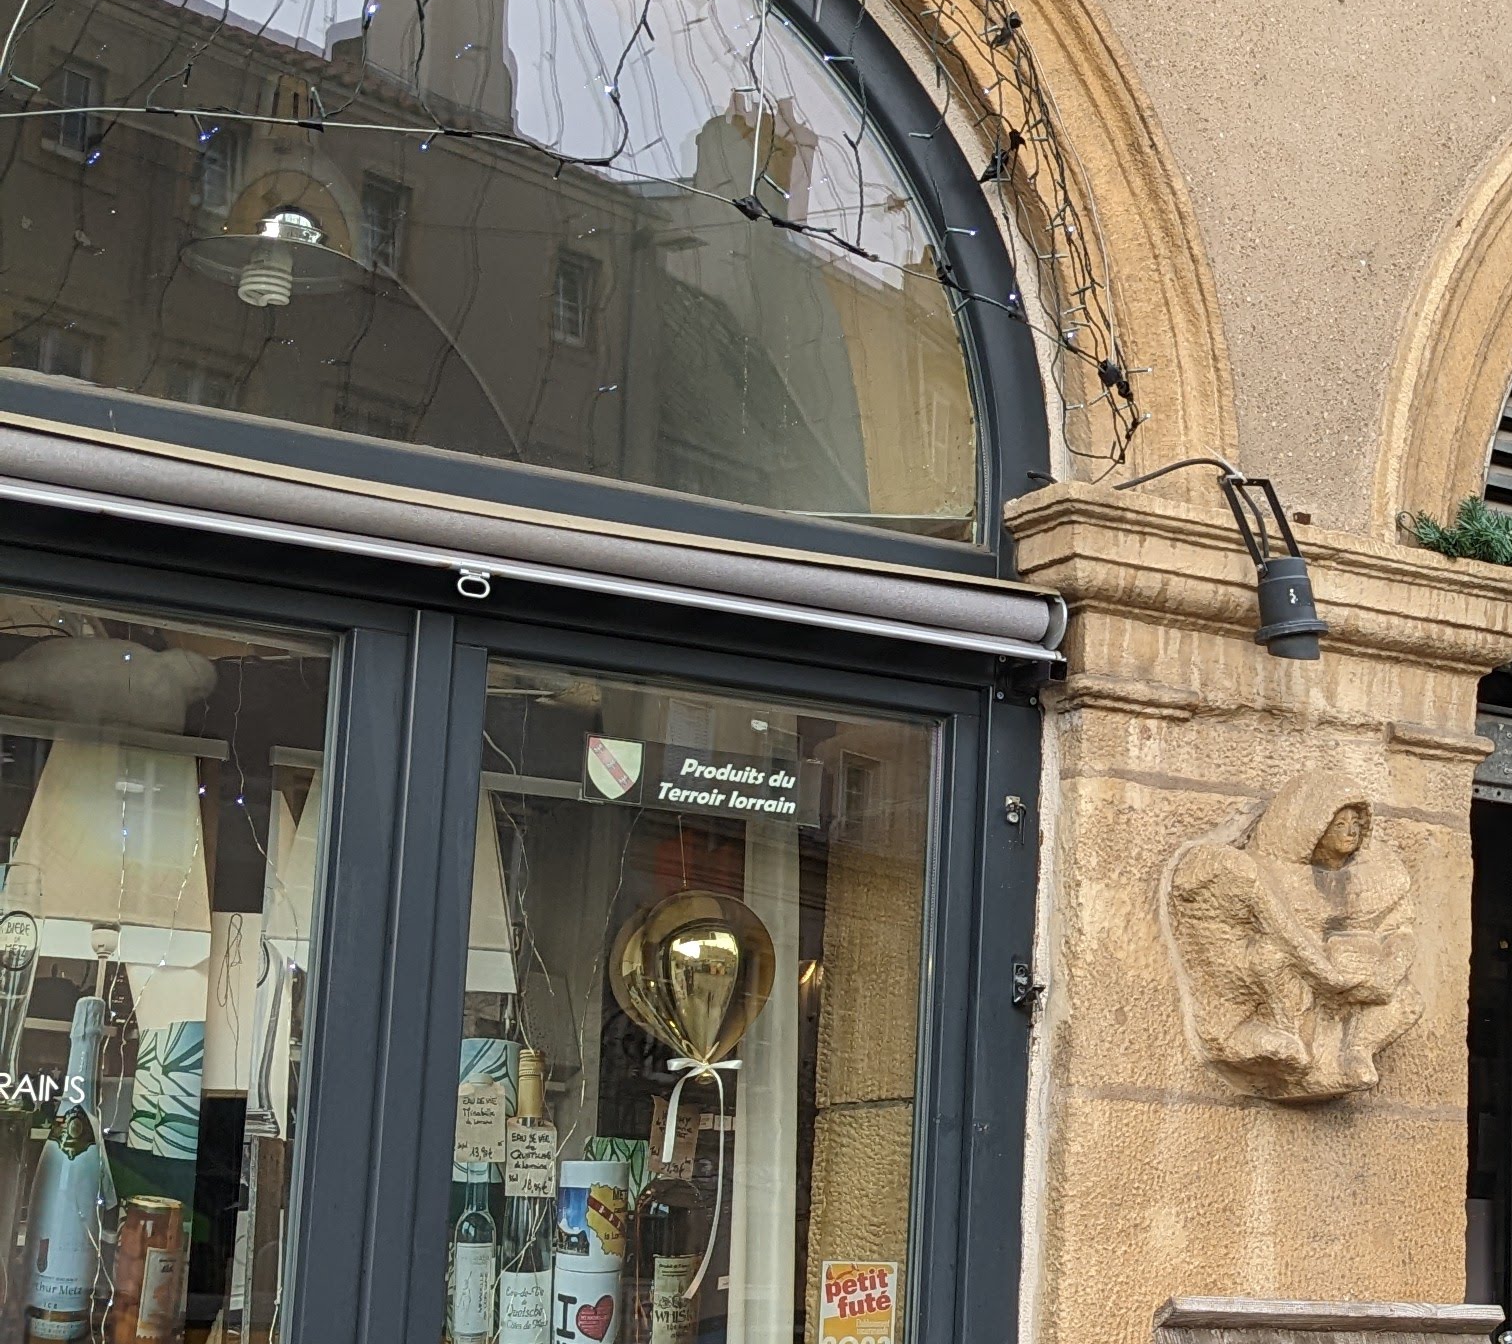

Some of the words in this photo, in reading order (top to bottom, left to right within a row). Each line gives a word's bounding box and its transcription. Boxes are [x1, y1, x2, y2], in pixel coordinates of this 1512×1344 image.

[680, 758, 765, 785] Produits
[769, 770, 796, 789] du
[658, 782, 726, 807] Terroir
[728, 791, 796, 814] lorrain
[825, 1268, 889, 1304] petit
[556, 1293, 578, 1340] I
[837, 1290, 892, 1318] futé
